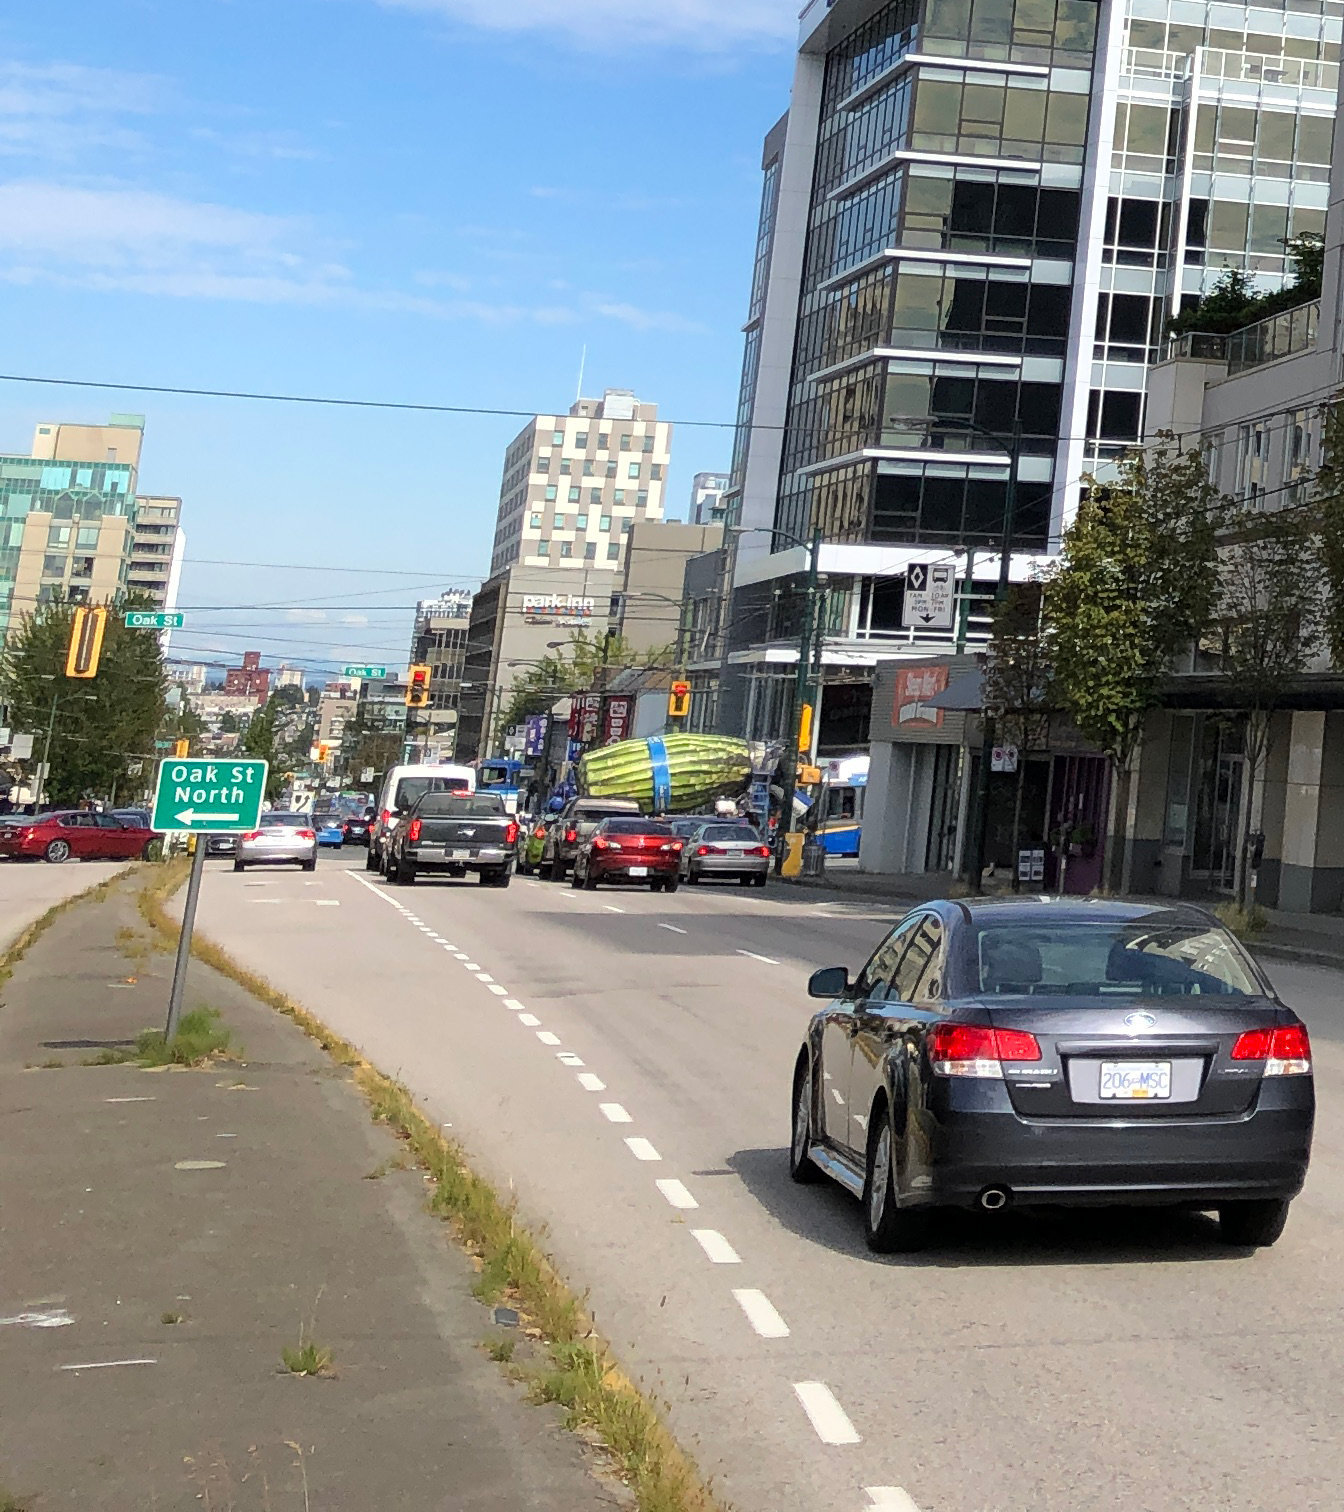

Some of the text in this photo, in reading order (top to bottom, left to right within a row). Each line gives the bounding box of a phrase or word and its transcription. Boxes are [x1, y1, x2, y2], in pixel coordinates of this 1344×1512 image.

[132, 614, 178, 626] Oak St
[349, 668, 381, 676] Oak St
[171, 765, 255, 783] Oak St
[174, 787, 244, 804] North
